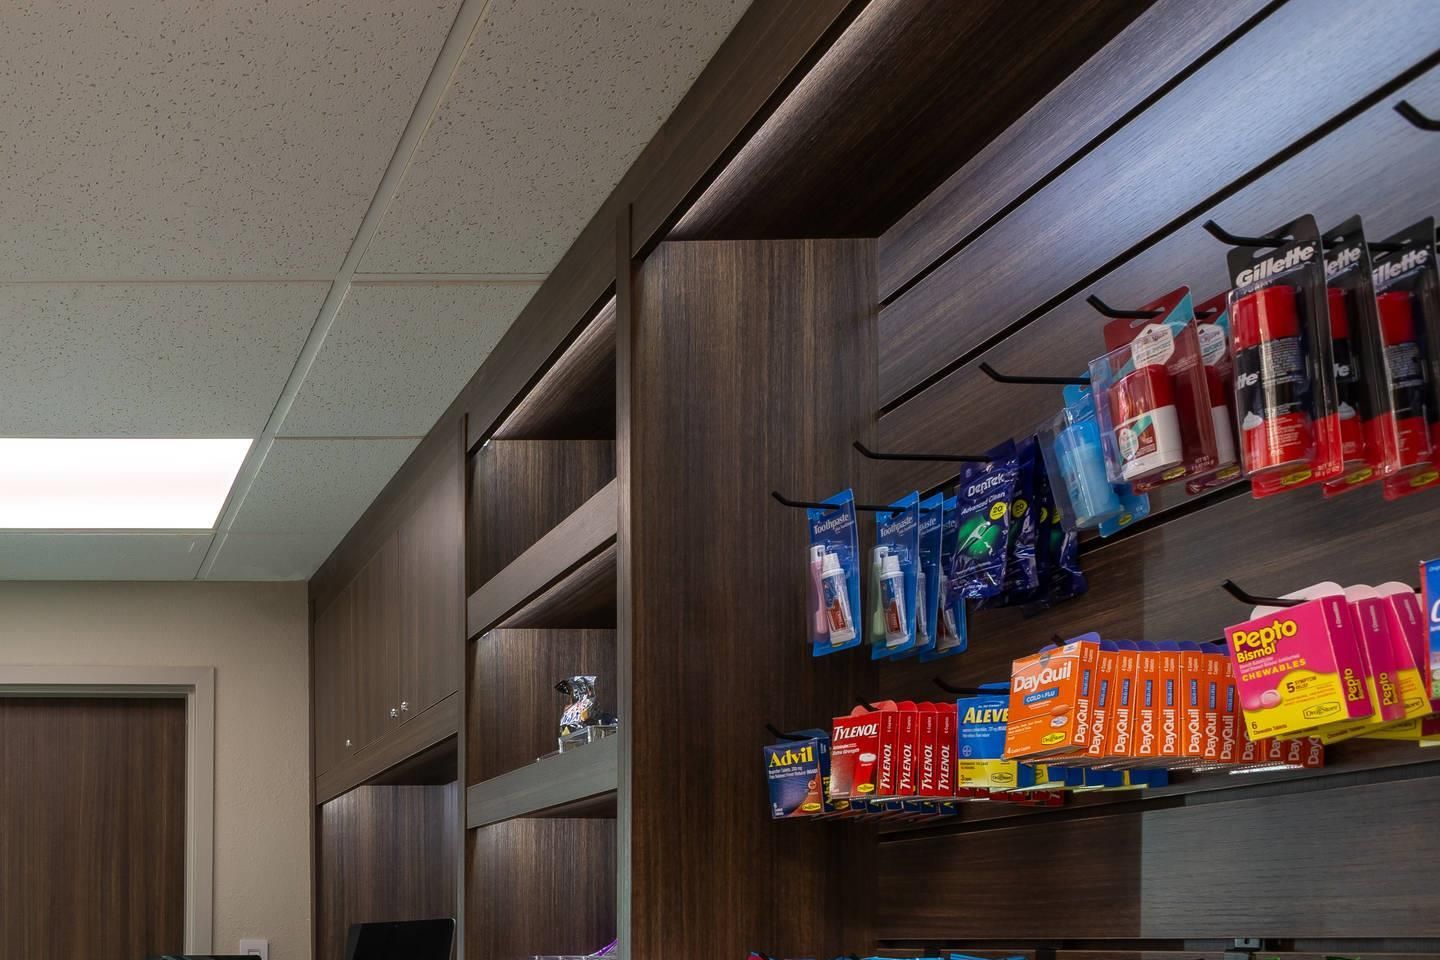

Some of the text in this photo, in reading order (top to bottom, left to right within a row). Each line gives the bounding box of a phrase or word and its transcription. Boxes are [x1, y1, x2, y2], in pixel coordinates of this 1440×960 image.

[1235, 245, 1315, 288] Gillette
[1324, 247, 1360, 276] lette
[967, 473, 1005, 497] DenTek
[960, 492, 1006, 516] Advanced Clean
[992, 505, 1003, 514] 20
[813, 513, 849, 535] Toothpaste
[880, 516, 913, 538] Toothpaste
[1232, 619, 1298, 651] Pepto
[1237, 643, 1276, 664] Bismol
[1013, 660, 1072, 692] DayQuil
[1242, 658, 1307, 682] CHEWABLES
[1343, 668, 1359, 701] Pepto
[1025, 695, 1041, 703] COLD
[1044, 690, 1056, 698] FLU
[1286, 682, 1296, 693] 5
[1380, 672, 1393, 706] Pepto
[962, 707, 1009, 724] ALEVE
[1074, 699, 1089, 743] DayQuil
[1114, 709, 1130, 753] DayQuil
[1163, 709, 1178, 753] DayQuil
[1188, 709, 1203, 753] DayQuil
[1251, 721, 1258, 730] 6
[833, 723, 879, 742] TYLENOL
[1089, 710, 1105, 755] DayQuil
[1140, 710, 1155, 754] DayQuil
[1205, 712, 1220, 757] DayQuil
[1221, 716, 1235, 760] DayQuil
[768, 746, 814, 768] Advil
[880, 743, 893, 789] TYLENOL
[900, 743, 913, 789] TYLENOL
[922, 743, 934, 790] TYLENOL
[938, 744, 951, 790] TYLENOL
